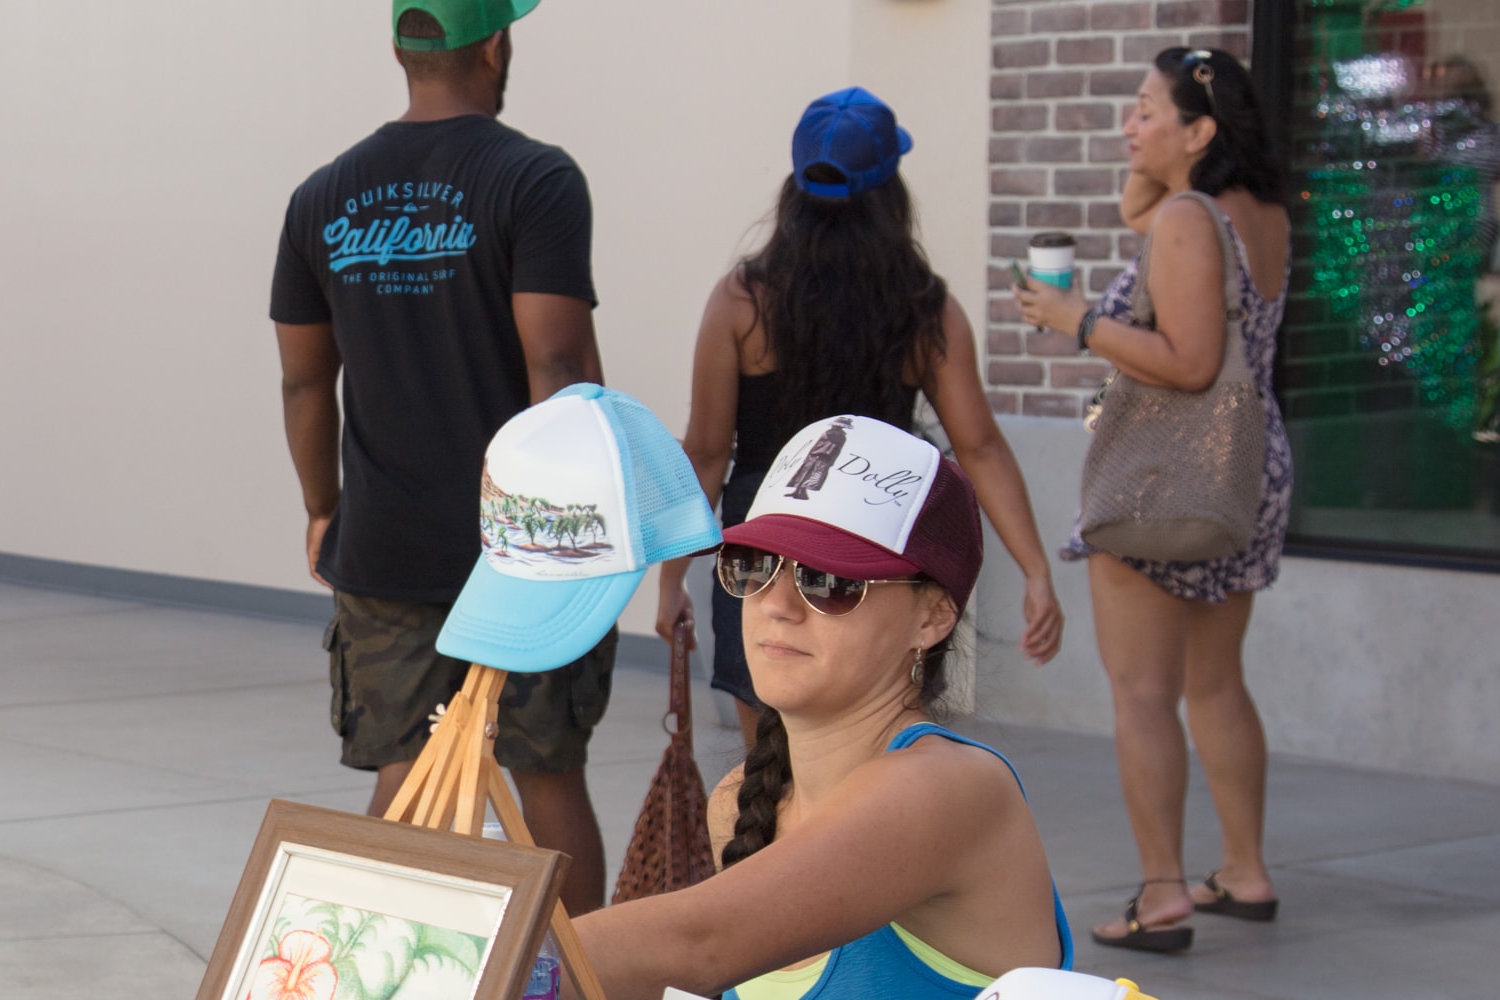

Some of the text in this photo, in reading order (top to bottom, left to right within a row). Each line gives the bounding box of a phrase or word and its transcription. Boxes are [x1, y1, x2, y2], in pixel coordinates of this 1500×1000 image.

[345, 182, 464, 214] QUIKSILVER
[323, 215, 477, 266] California
[342, 272, 362, 284] THE
[369, 271, 429, 282] ORIGINAL
[376, 284, 434, 294] COMPANY
[837, 453, 922, 505] Dolly
